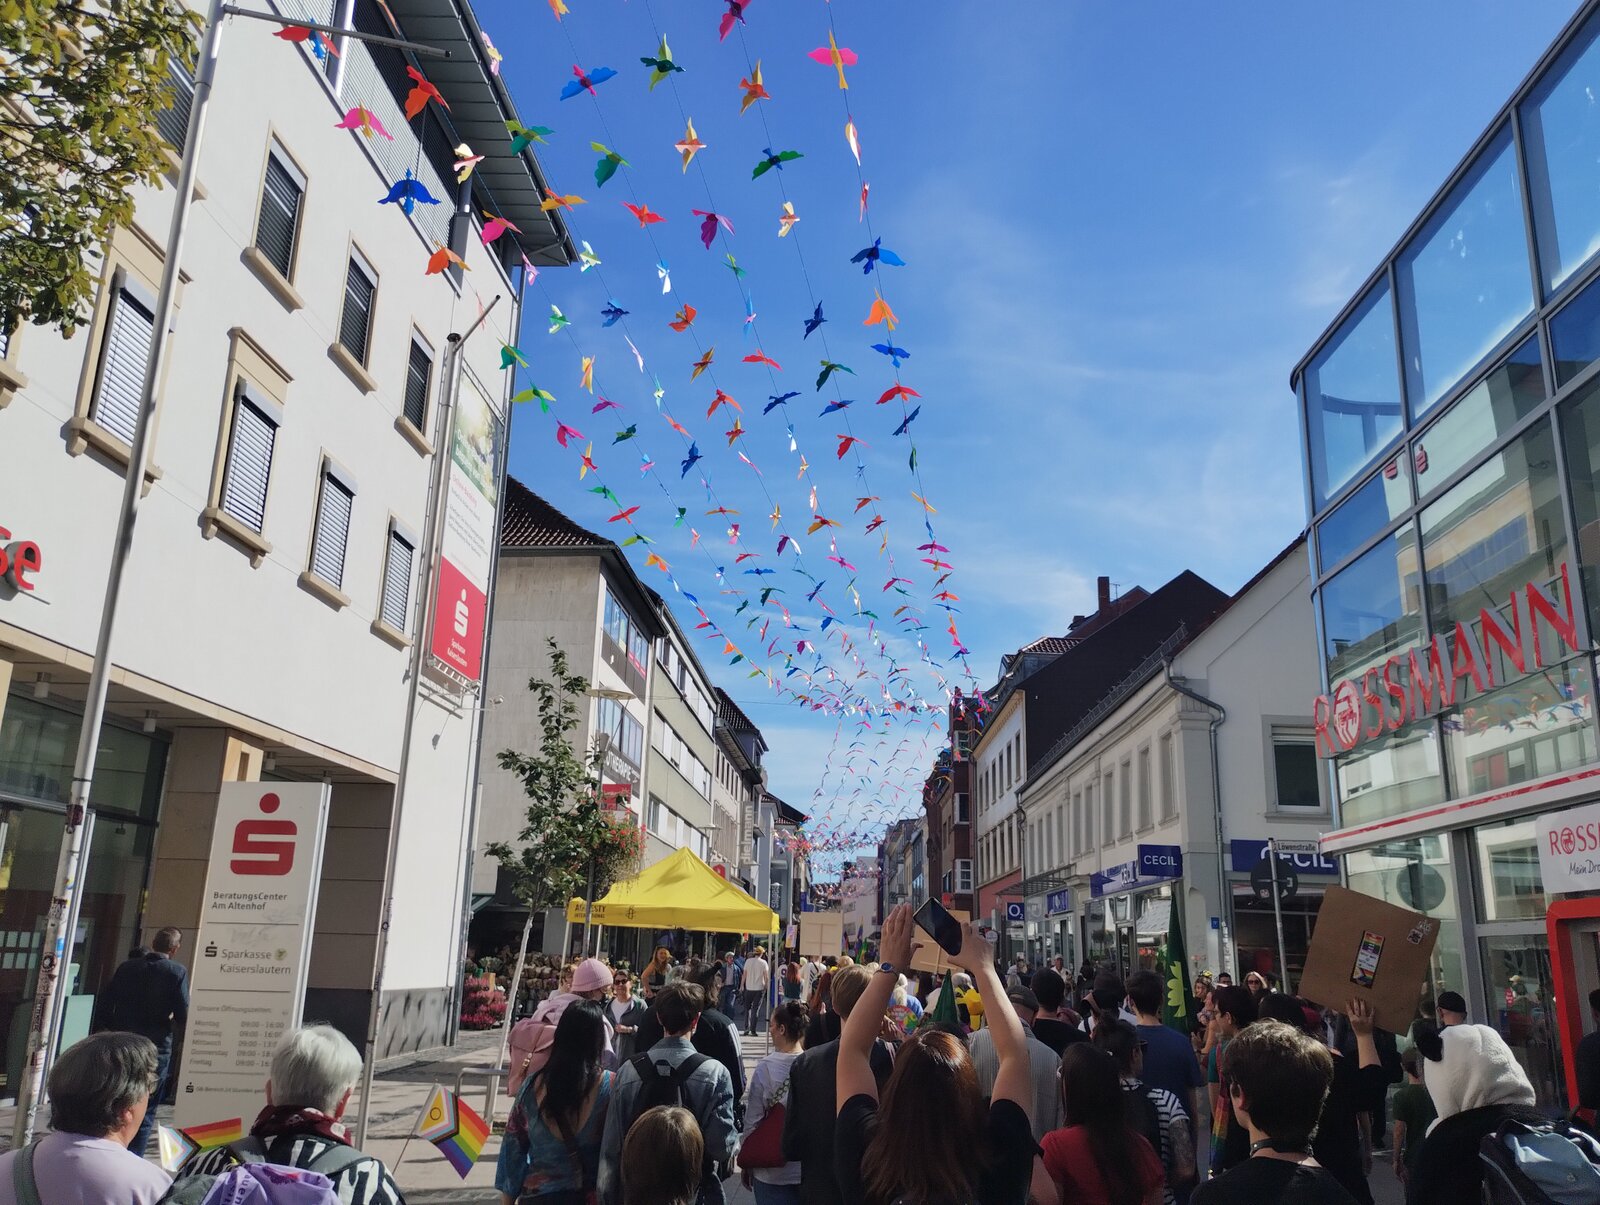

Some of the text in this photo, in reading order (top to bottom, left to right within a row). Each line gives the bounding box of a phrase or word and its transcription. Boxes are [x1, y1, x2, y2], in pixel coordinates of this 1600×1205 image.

[1313, 562, 1580, 759] ROSSMANN
[740, 805, 753, 865] dielmann
[1549, 822, 1600, 856] ROSS
[1278, 841, 1317, 851] Löwenstraße
[1143, 855, 1178, 866] CECIL
[1569, 862, 1587, 875] Mein
[213, 891, 288, 901] BeratungsCenter
[211, 901, 267, 910] Am Altenhof
[221, 948, 272, 960] Sparkasse
[220, 963, 291, 975] Kaiserslautern
